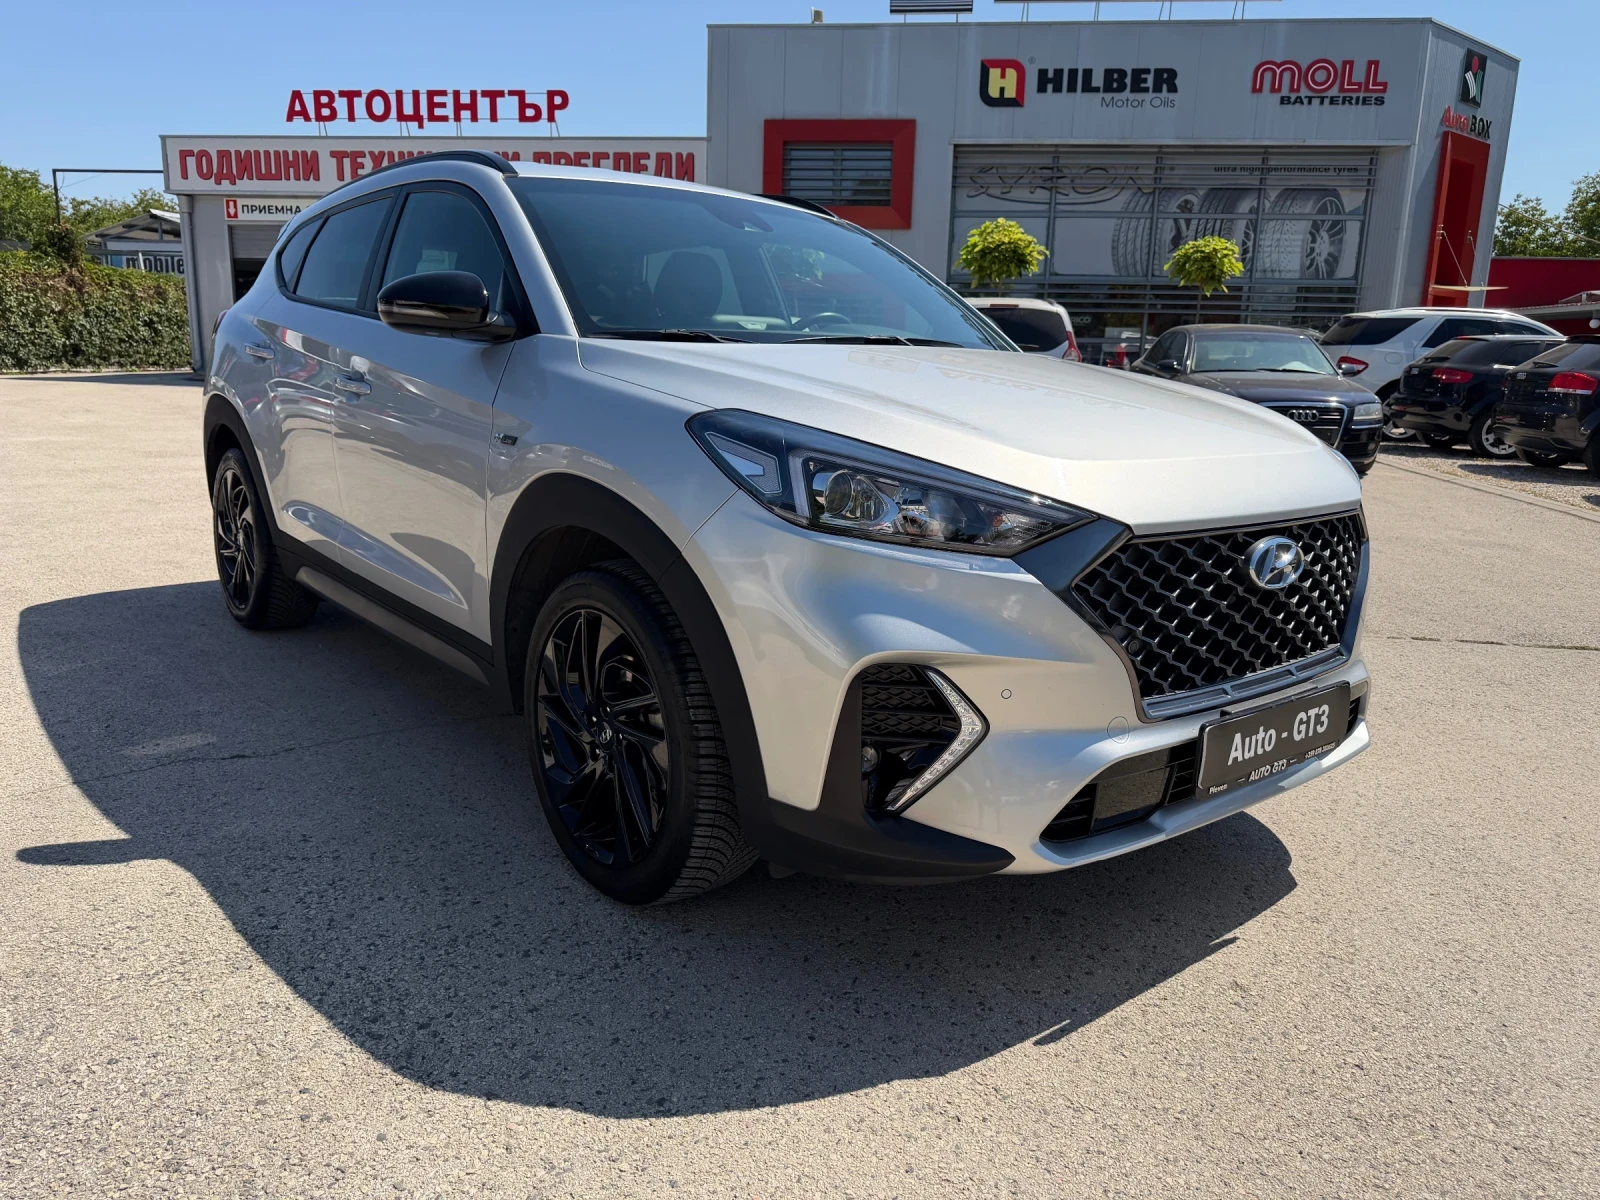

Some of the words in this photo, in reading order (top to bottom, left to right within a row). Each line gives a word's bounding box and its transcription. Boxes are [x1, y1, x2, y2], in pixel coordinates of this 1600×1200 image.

[1036, 68, 1178, 93] HILBER
[285, 88, 569, 129] АВТОЦЕНТЪР
[1101, 96, 1145, 108] Motor
[1150, 96, 1176, 108] Oils
[1279, 95, 1386, 106] BATTERIES
[178, 149, 320, 185] ГОДИШНИ
[241, 204, 302, 215] ПРИЕМНА
[1227, 725, 1276, 766] Auto
[1293, 704, 1330, 742] GT3
[1209, 783, 1228, 795] Pleven
[1248, 764, 1271, 782] AUTO
[1272, 758, 1287, 774] GT3
